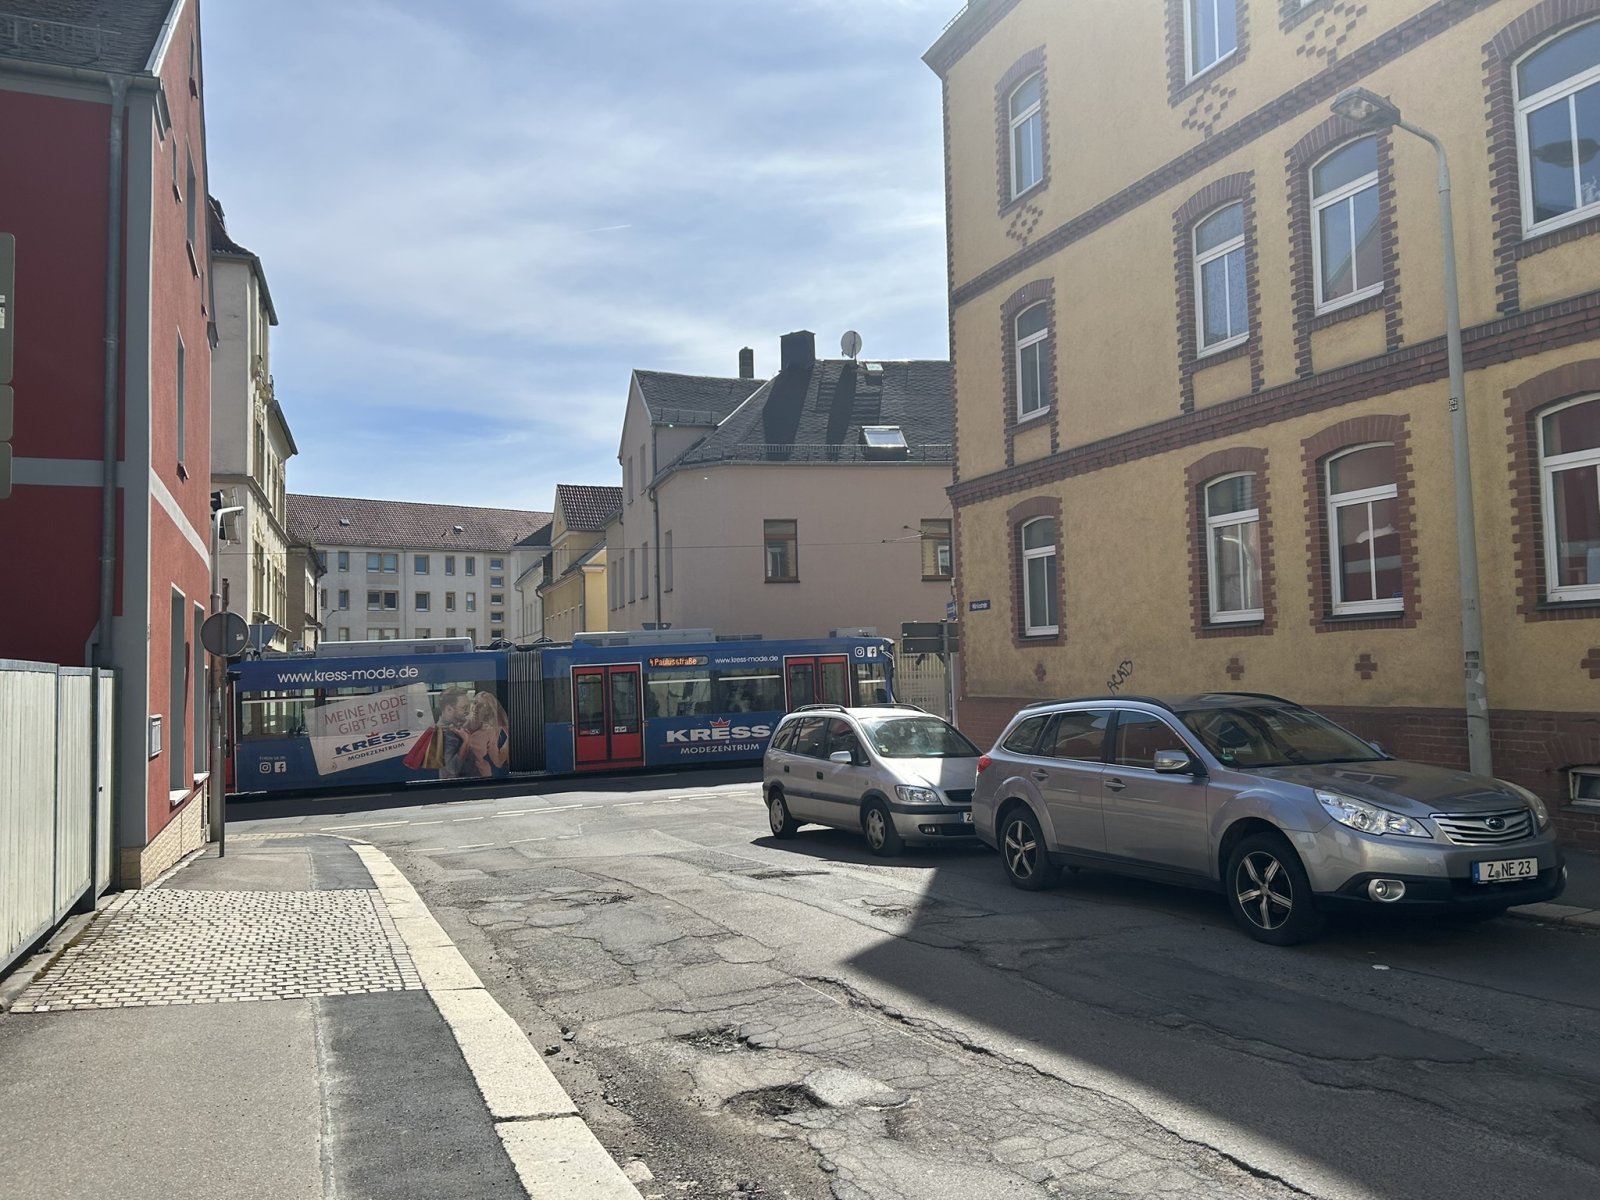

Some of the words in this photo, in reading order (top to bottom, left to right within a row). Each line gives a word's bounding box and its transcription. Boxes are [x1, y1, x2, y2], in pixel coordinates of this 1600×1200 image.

[654, 657, 697, 666] Paulusstraße
[714, 655, 778, 664] www.kress-mode.de
[277, 666, 419, 684] www.kress-mode.de
[324, 705, 365, 726] MEINE
[367, 694, 408, 715] MODE
[338, 713, 378, 735] GIBT'S
[381, 711, 401, 726] BEI
[335, 729, 412, 755] KRESS
[666, 724, 772, 743] KRESS
[347, 742, 405, 761] MODEZENTRUM
[680, 743, 760, 755] MODEZENTRUM
[1487, 863, 1495, 878] Z
[1501, 862, 1516, 876] NE
[1518, 860, 1531, 874] 23
